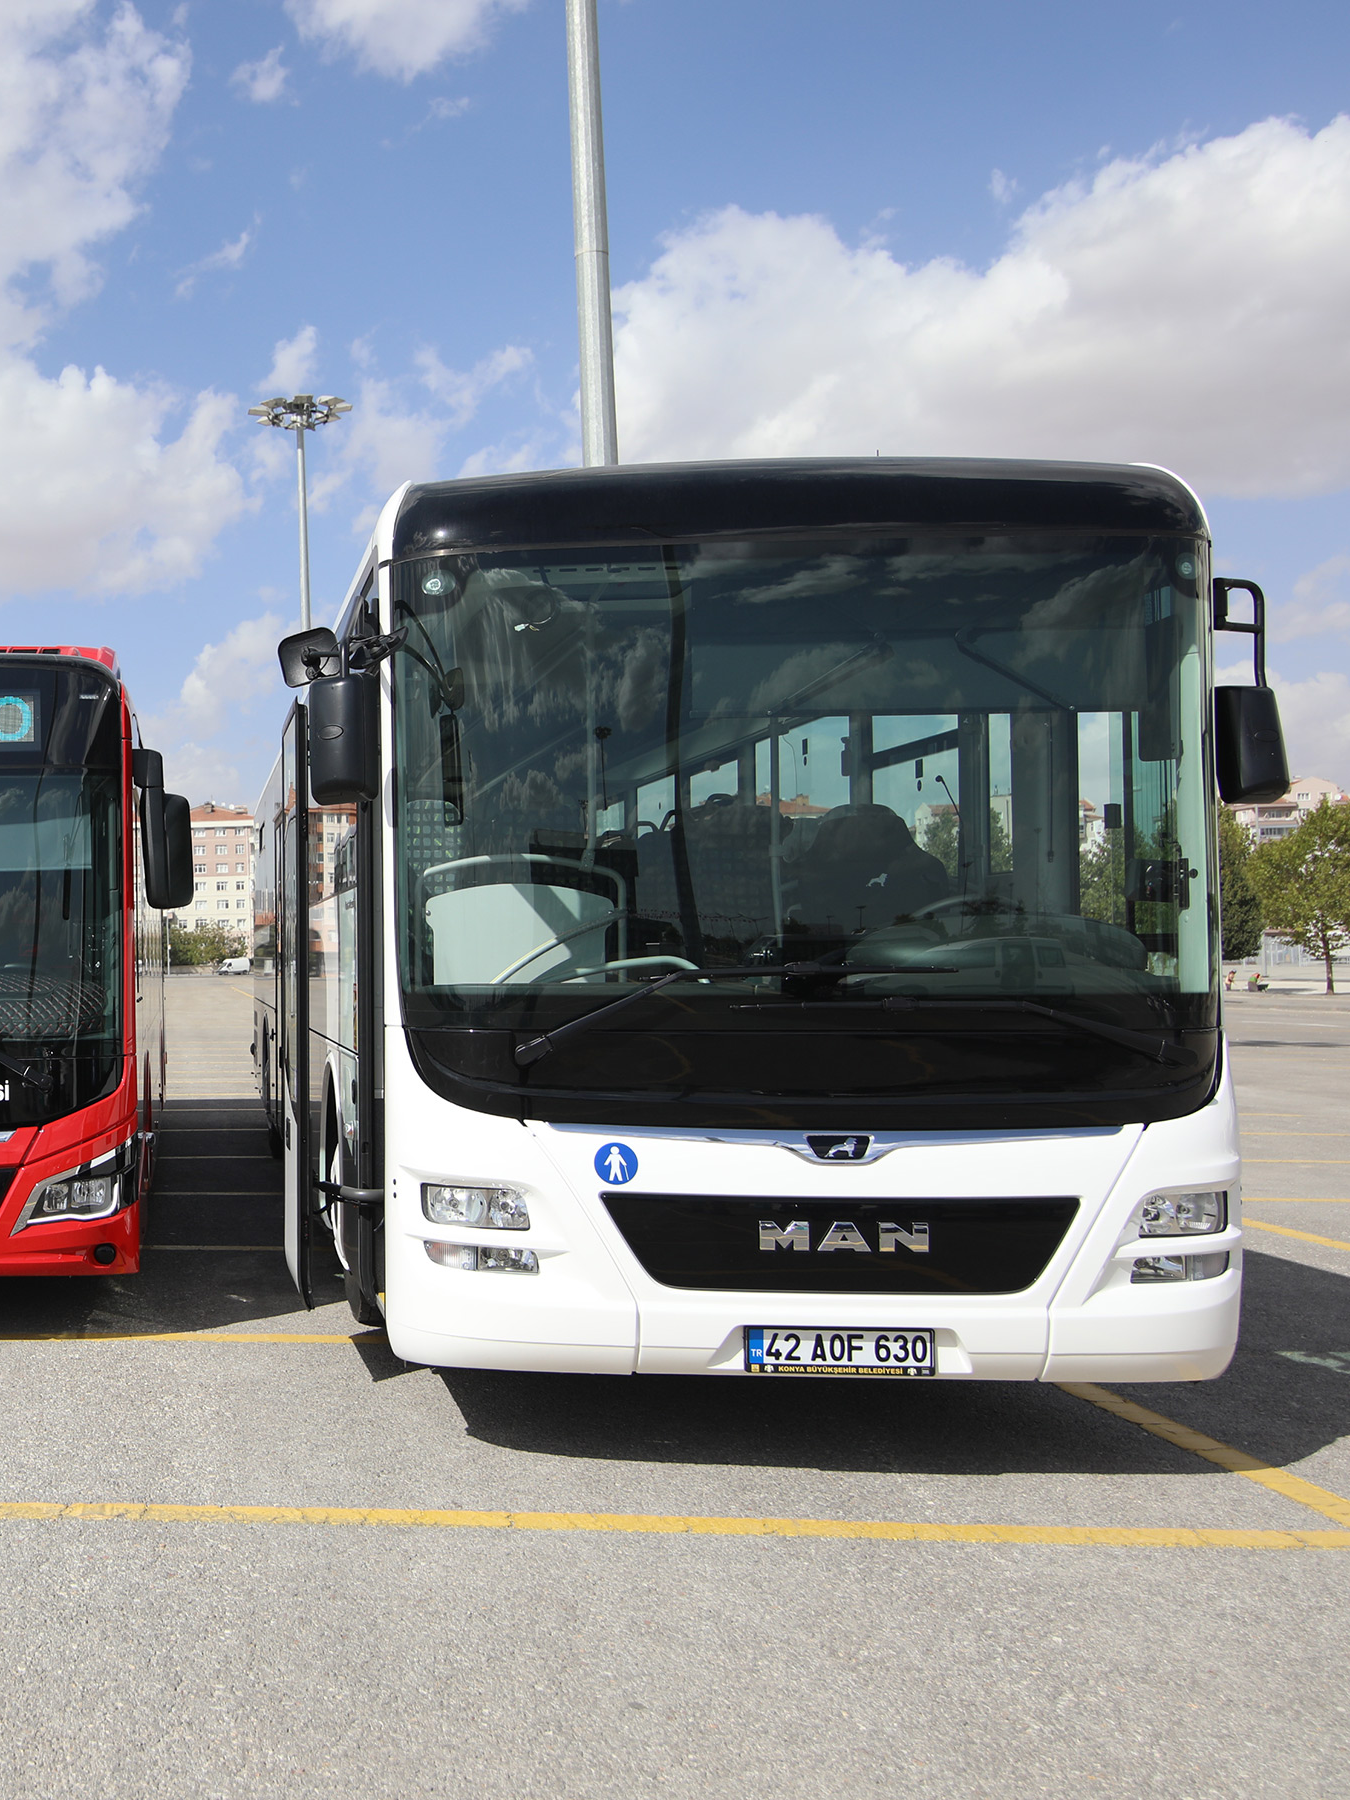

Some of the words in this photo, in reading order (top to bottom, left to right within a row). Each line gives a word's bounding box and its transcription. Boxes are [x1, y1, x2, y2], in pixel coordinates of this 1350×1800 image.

[759, 1220, 930, 1252] MAN
[751, 1349, 763, 1357] TR
[765, 1333, 801, 1361] 42
[811, 1334, 864, 1362] AOF
[874, 1335, 928, 1363] 630
[806, 1365, 856, 1375] BÜYÜKŞEHİR
[858, 1366, 903, 1375] BELEDİYESİ
